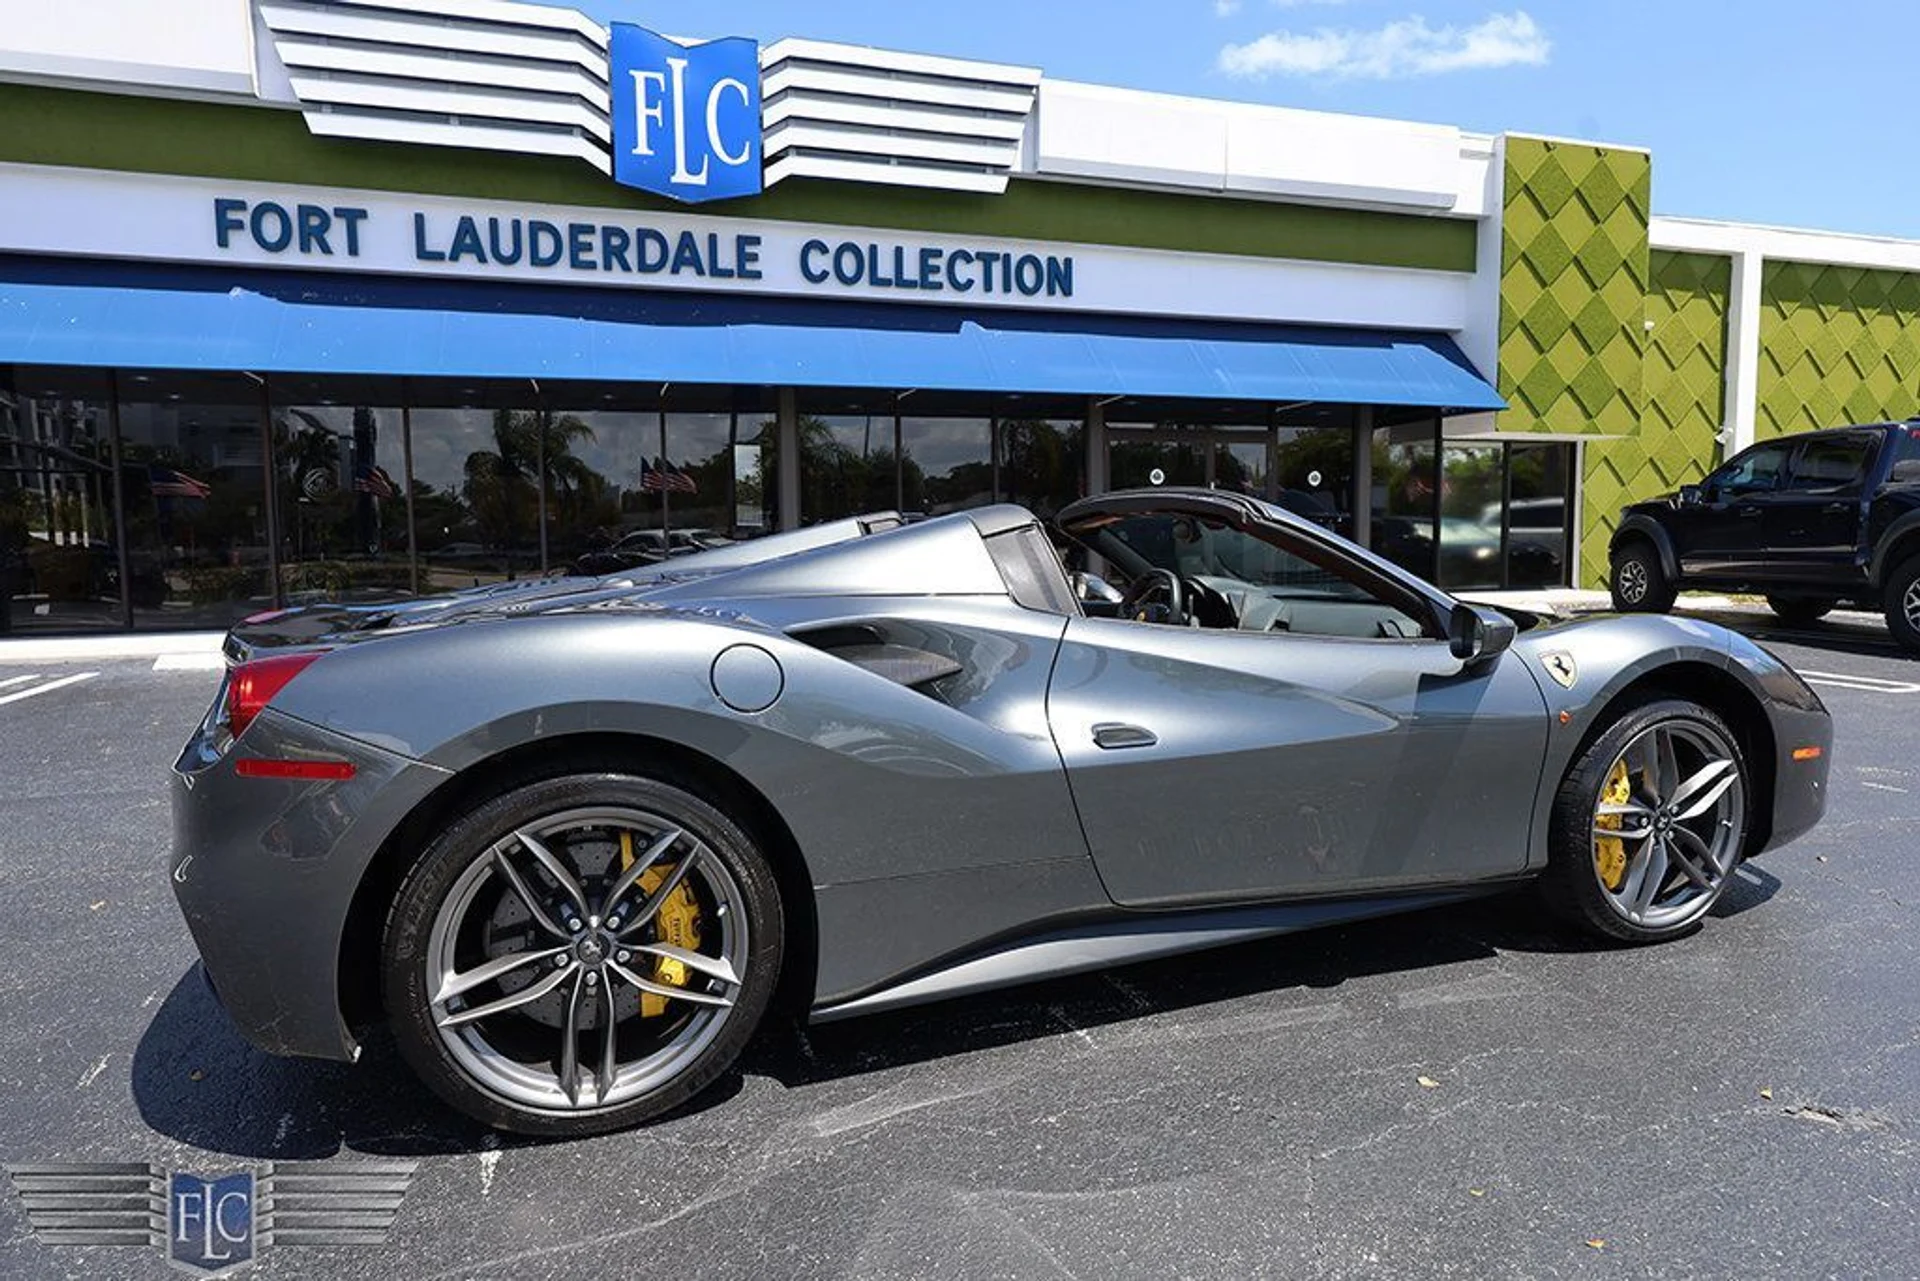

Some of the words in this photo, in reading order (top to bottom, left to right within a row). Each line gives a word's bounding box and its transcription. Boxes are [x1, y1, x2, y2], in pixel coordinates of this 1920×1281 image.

[628, 57, 750, 185] FLC
[214, 198, 368, 256] FORT
[414, 212, 763, 279] LAUDERDALE
[800, 239, 1073, 297] COLLECTION
